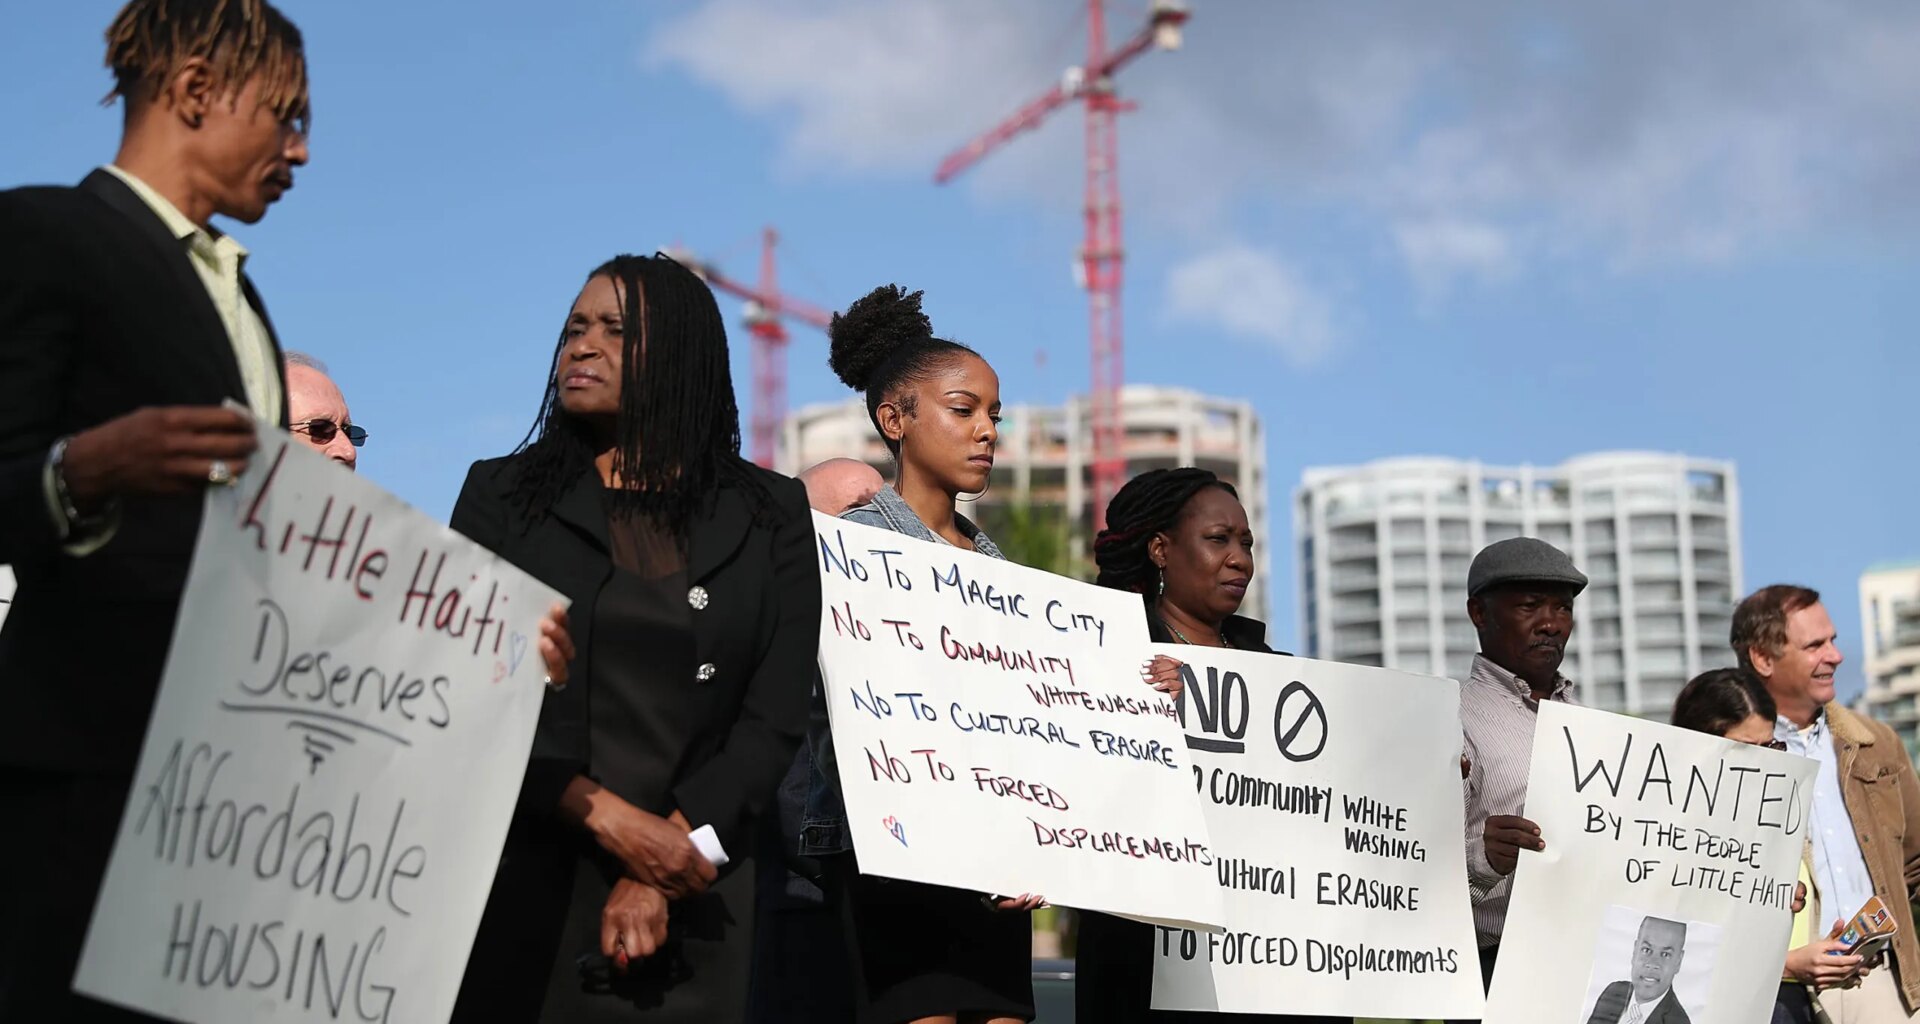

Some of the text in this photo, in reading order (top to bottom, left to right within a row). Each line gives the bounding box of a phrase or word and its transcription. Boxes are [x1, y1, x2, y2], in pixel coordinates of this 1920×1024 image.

[240, 441, 508, 656] Little Haiti
[932, 563, 1029, 619] MAGIC
[1045, 600, 1105, 647] CITY
[239, 599, 449, 729] Deserves
[940, 625, 1076, 685] COMMUNITY
[950, 702, 1080, 749] CULTURAL
[1088, 730, 1179, 770] ERASURE
[1176, 663, 1250, 740] NO
[970, 767, 1069, 811] FORCED
[1563, 726, 1801, 835] WANTED
[136, 737, 426, 916] Affordable
[1027, 817, 1212, 866] DISPLACEMENTS
[1584, 805, 1762, 869] BY THE PEOPLE
[1216, 857, 1420, 912] ultural ERASURE
[1626, 859, 1793, 911] OF LITTLE HAITI
[162, 900, 396, 1024] HOUSING
